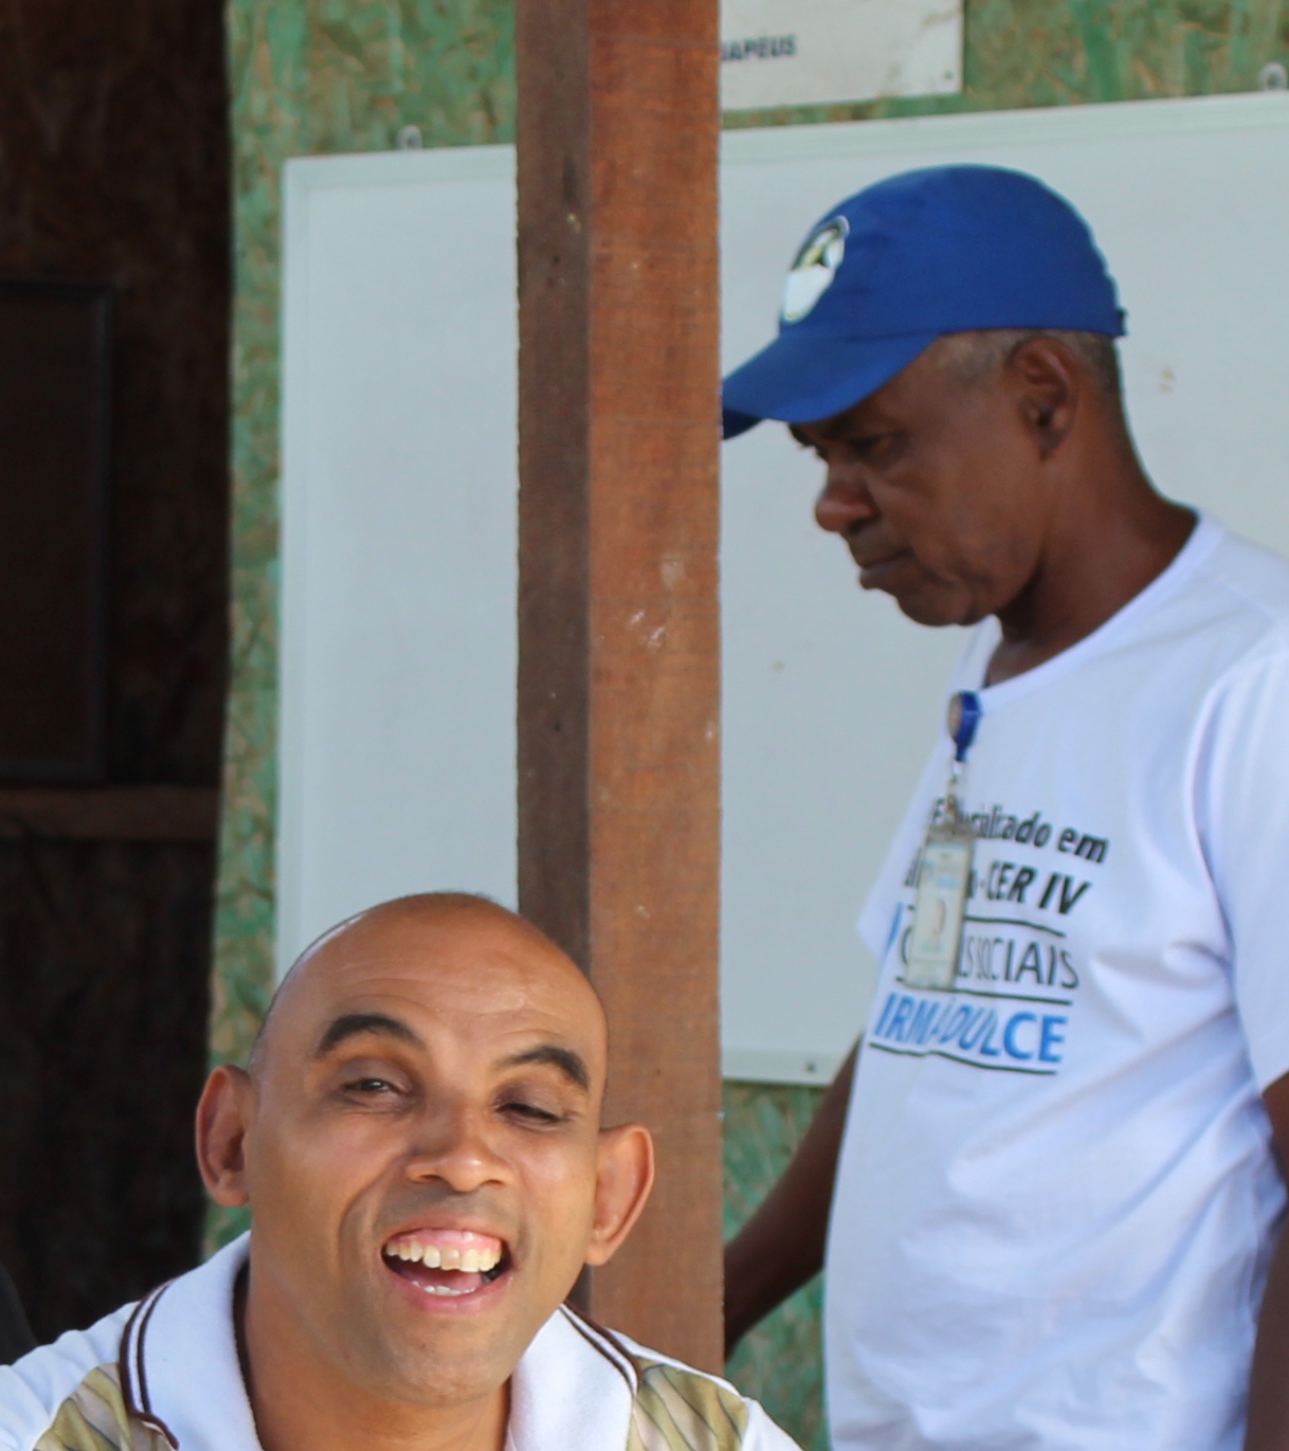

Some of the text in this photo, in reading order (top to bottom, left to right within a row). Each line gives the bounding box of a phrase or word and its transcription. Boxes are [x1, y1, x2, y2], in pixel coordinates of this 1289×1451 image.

[1057, 827, 1110, 864] em
[987, 861, 1038, 904] CER
[1039, 871, 1093, 914] IV
